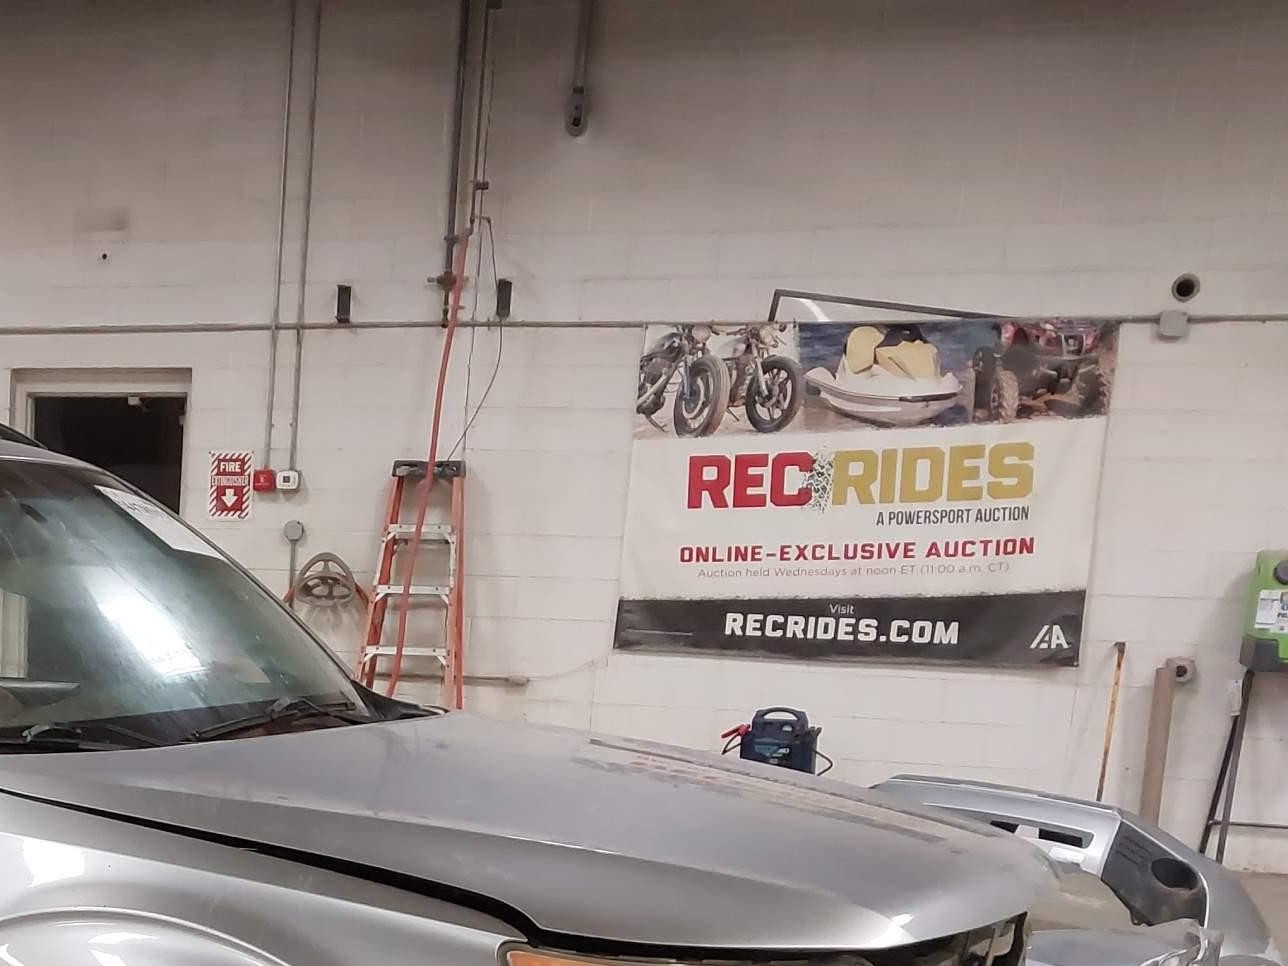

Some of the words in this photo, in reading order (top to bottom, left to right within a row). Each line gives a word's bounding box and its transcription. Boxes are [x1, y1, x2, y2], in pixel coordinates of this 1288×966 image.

[220, 461, 242, 473] FIRE
[687, 451, 816, 508] REC
[832, 442, 1035, 505] RIDES
[876, 512, 885, 526] A
[888, 508, 972, 526] POWERSPORT
[975, 506, 1030, 523] AUCTION
[679, 542, 917, 563] ONLINE-EXCLUSIVE
[925, 537, 1035, 559] AUCTION
[698, 567, 742, 578] Auction
[745, 567, 770, 577] held
[774, 567, 847, 579] Wednesdays
[850, 567, 862, 576] at
[866, 567, 897, 576] noon
[901, 565, 915, 575] ET
[988, 562, 1011, 573] CT)
[830, 602, 855, 615] Visit
[724, 612, 960, 645] RECRIDES.COM
